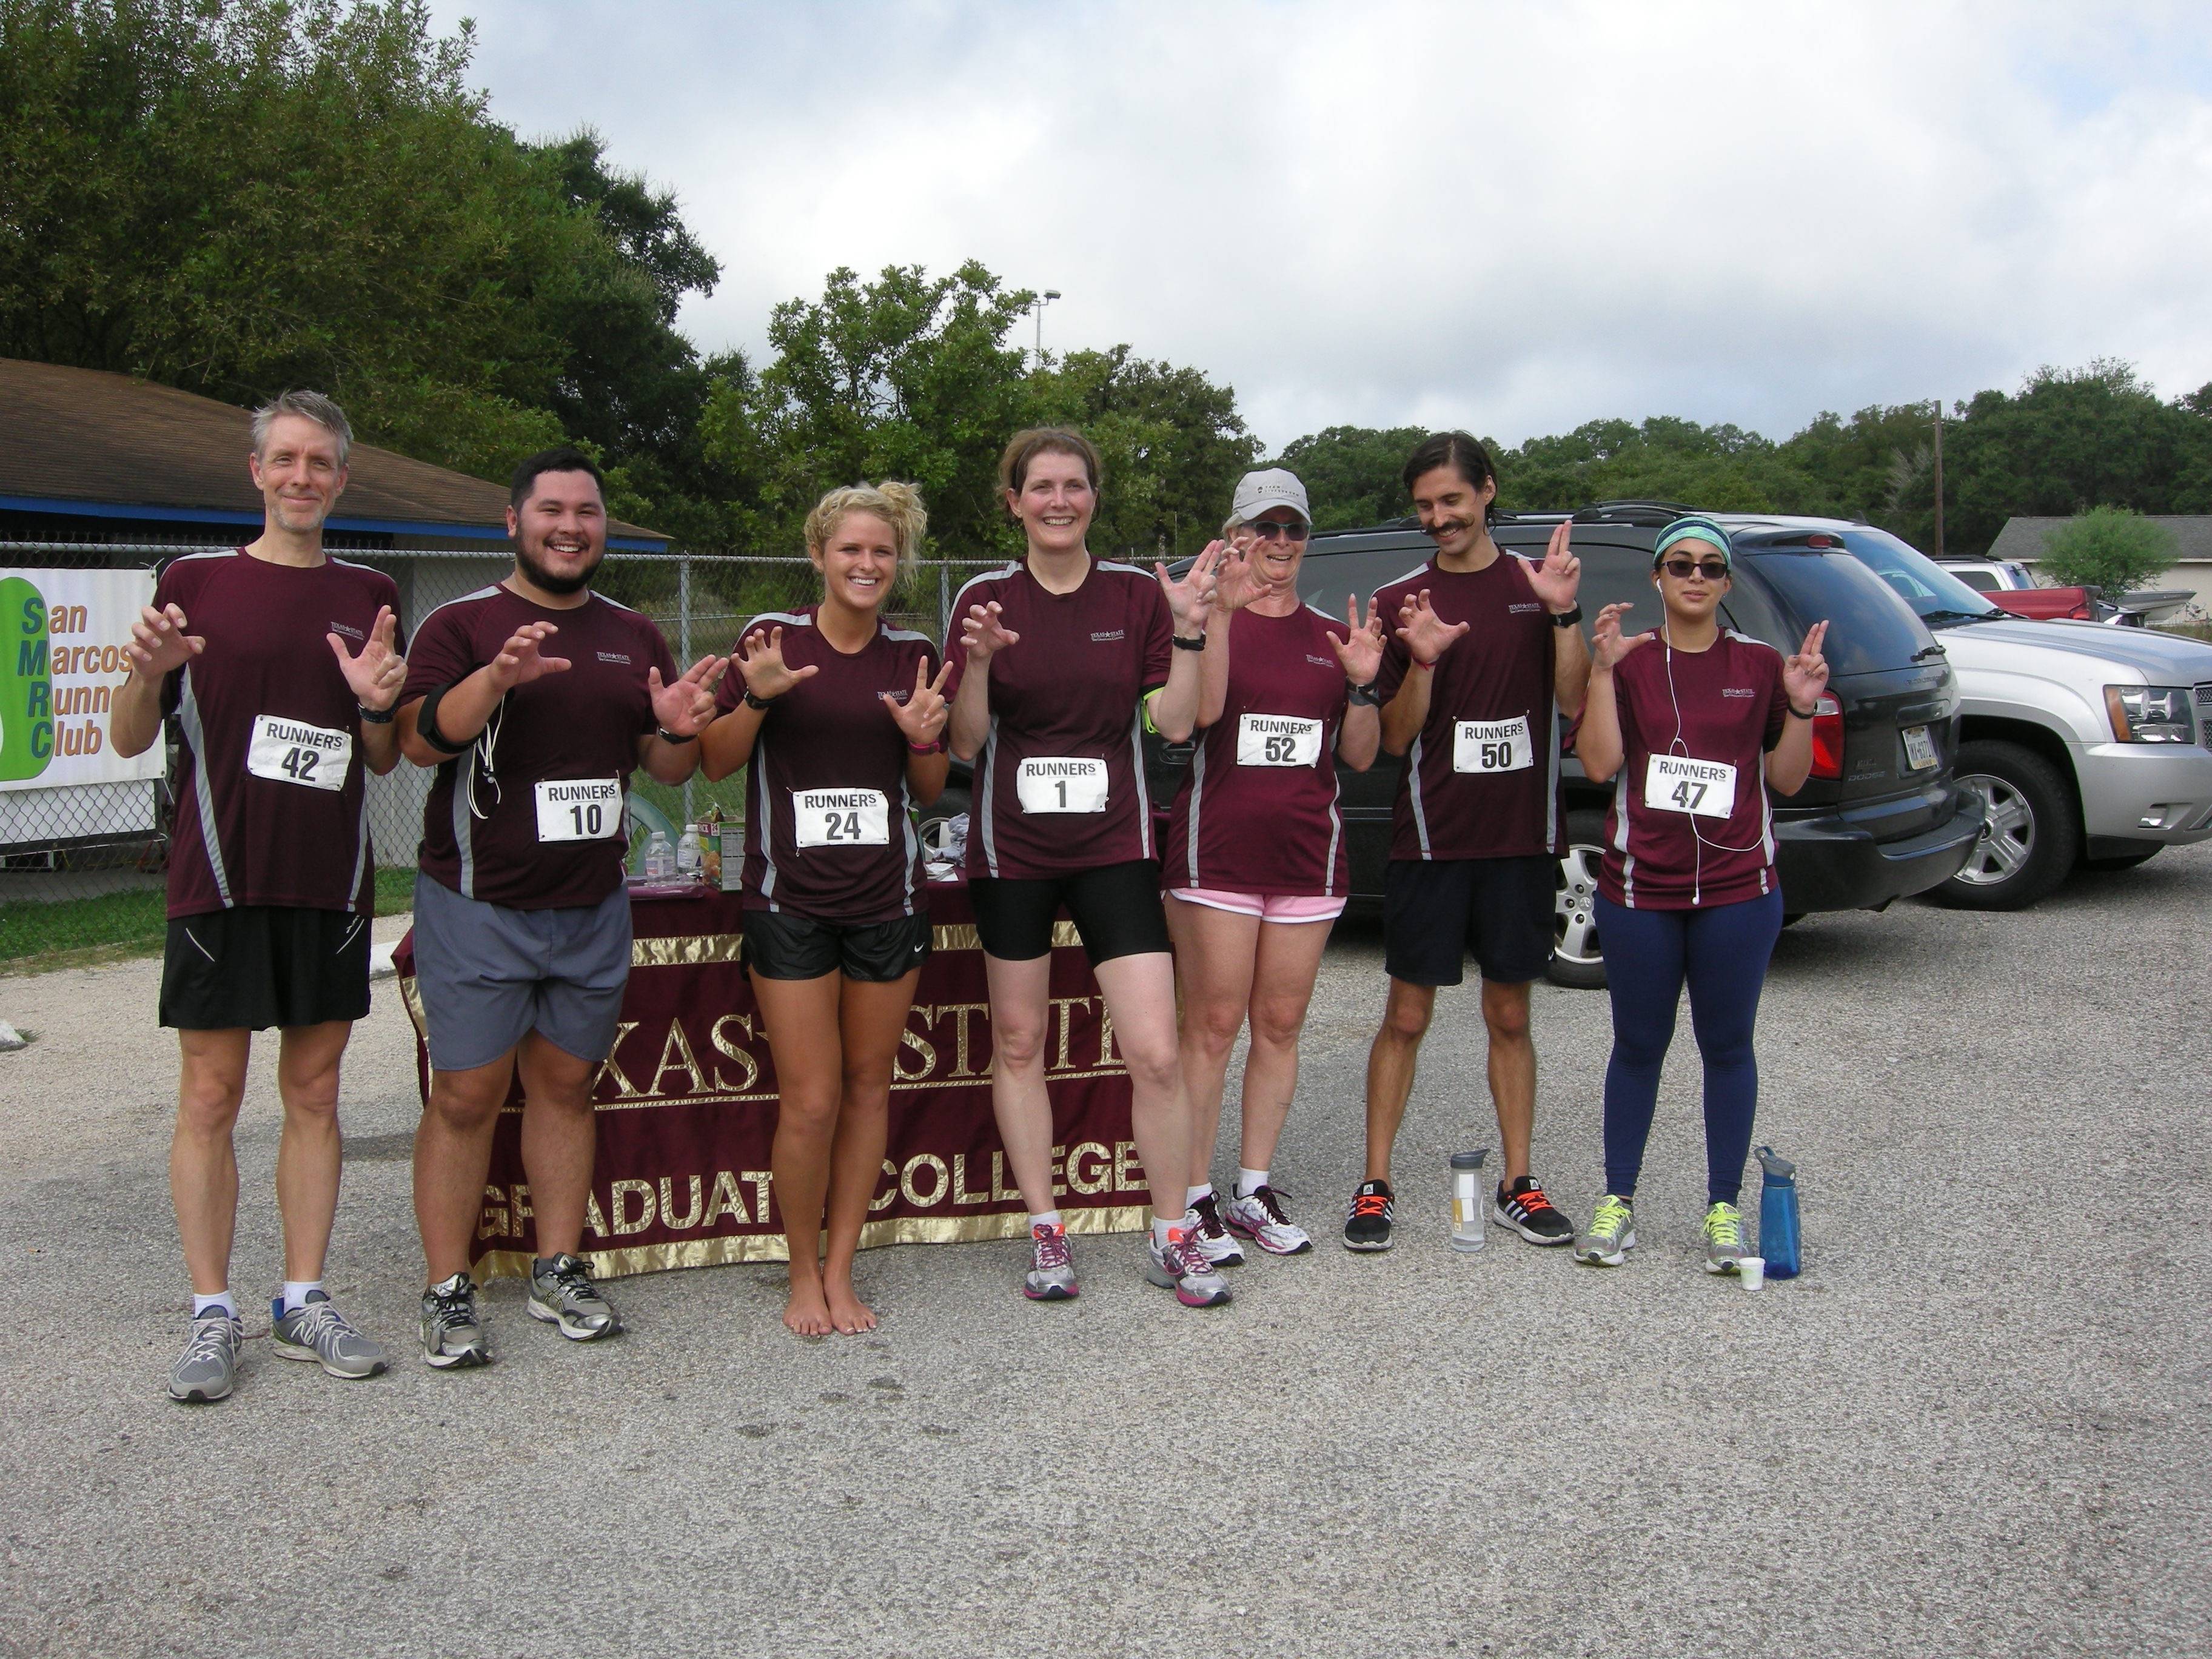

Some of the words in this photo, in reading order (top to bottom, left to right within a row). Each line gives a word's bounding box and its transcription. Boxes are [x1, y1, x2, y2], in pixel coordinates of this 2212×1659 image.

[22, 597, 87, 634] San
[18, 640, 133, 676] Marcos
[32, 720, 102, 758] Club
[1265, 737, 1296, 762] 52
[281, 747, 320, 782] 42
[1482, 742, 1512, 768] 50
[1054, 780, 1066, 808] 1
[1672, 780, 1708, 809] 47
[570, 804, 602, 835] 10
[825, 813, 861, 840] 24
